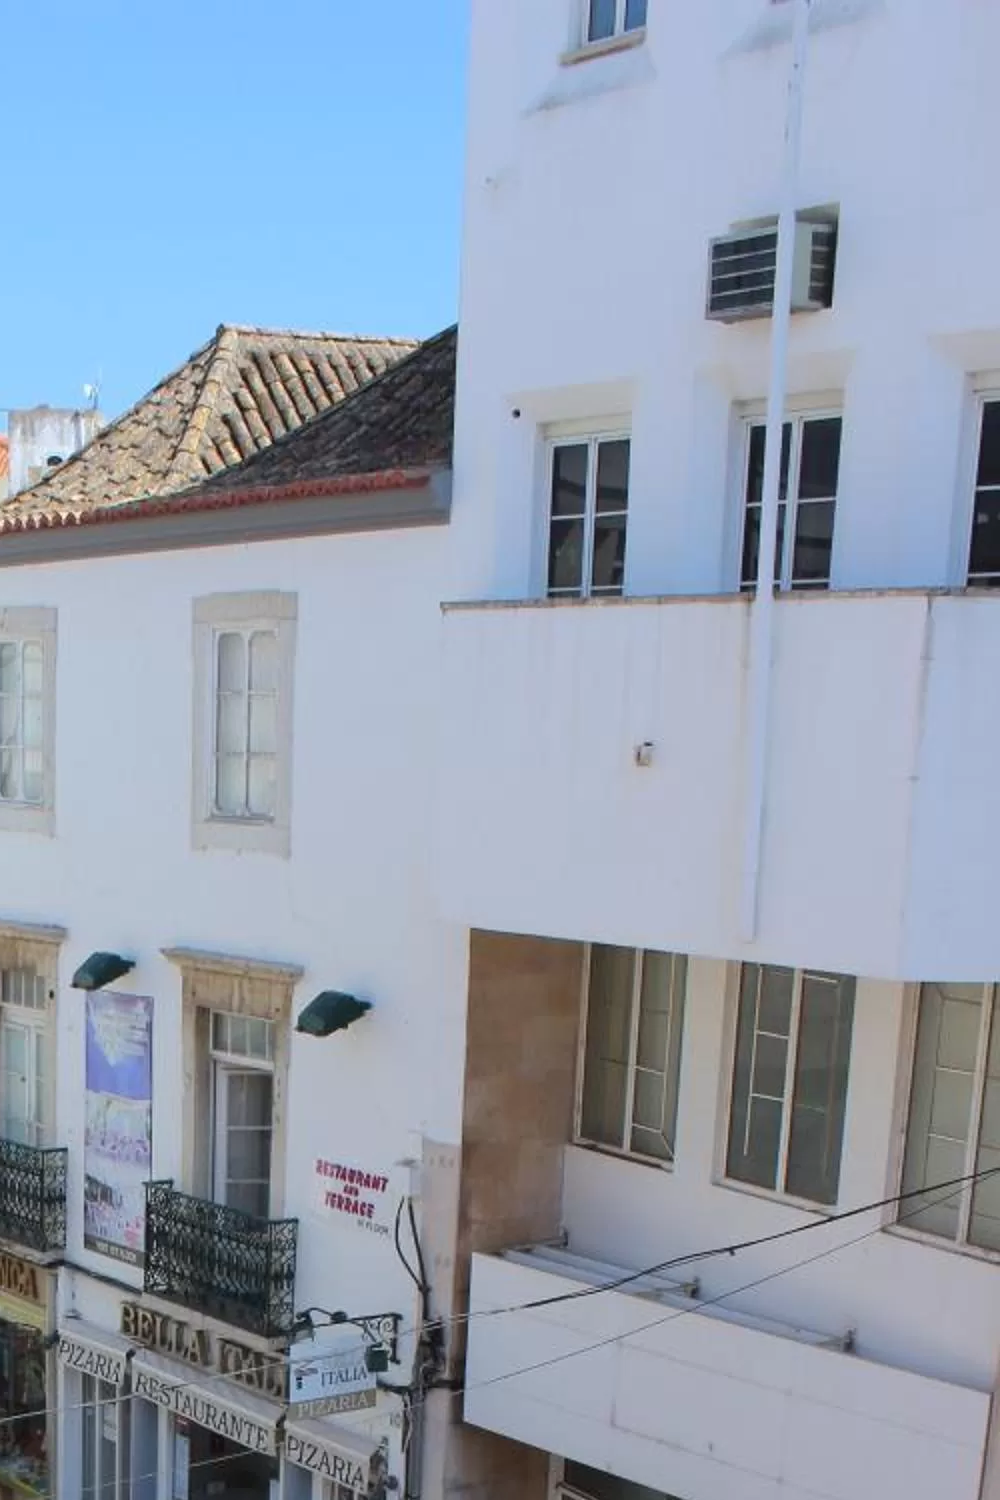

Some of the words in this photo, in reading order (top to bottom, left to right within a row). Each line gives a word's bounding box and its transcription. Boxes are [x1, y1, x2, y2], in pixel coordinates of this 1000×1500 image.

[315, 1159, 389, 1193] RESTAURANT
[325, 1192, 375, 1219] TERRACE
[120, 1301, 211, 1367] BELLA
[217, 1338, 286, 1398] ITAL
[320, 1366, 368, 1387] ITALIA
[135, 1372, 269, 1451] RESTAURANTE
[297, 1391, 369, 1418] PIZARIA
[287, 1435, 366, 1490] PIZARIA
